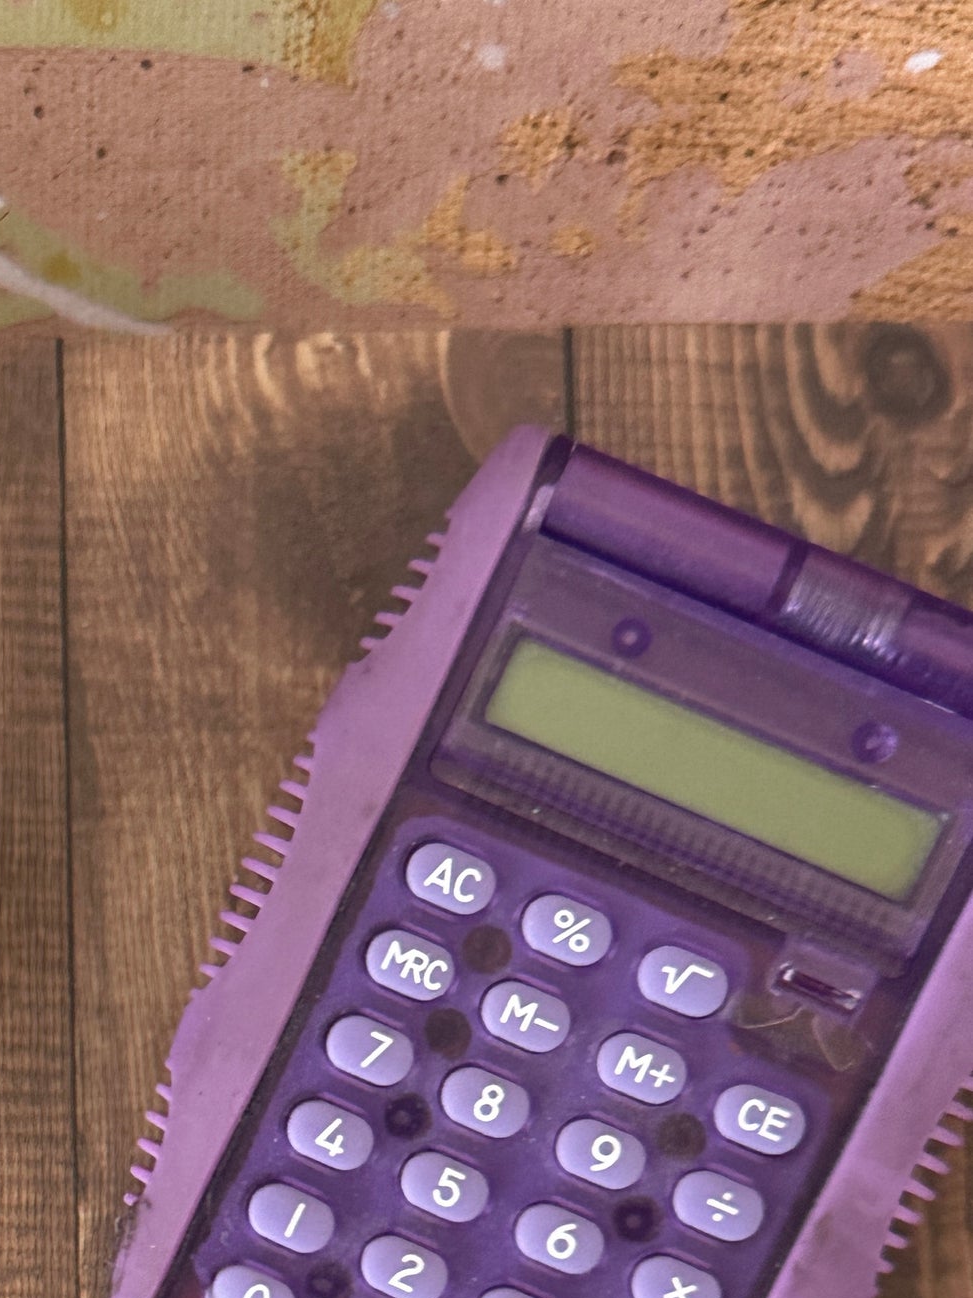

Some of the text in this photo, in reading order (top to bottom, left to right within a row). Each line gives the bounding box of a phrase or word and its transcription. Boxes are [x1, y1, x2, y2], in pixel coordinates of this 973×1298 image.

[422, 857, 480, 901] AC
[552, 909, 590, 951] %
[380, 940, 448, 989] MRC
[359, 1031, 393, 1068] 7
[613, 1045, 675, 1087] M+
[472, 1084, 504, 1122] 8
[737, 1098, 790, 1140] CE
[314, 1118, 344, 1156] 4
[589, 1134, 621, 1171] 9
[431, 1167, 465, 1207] 5
[545, 1223, 576, 1259] 6
[387, 1253, 424, 1293] 2
